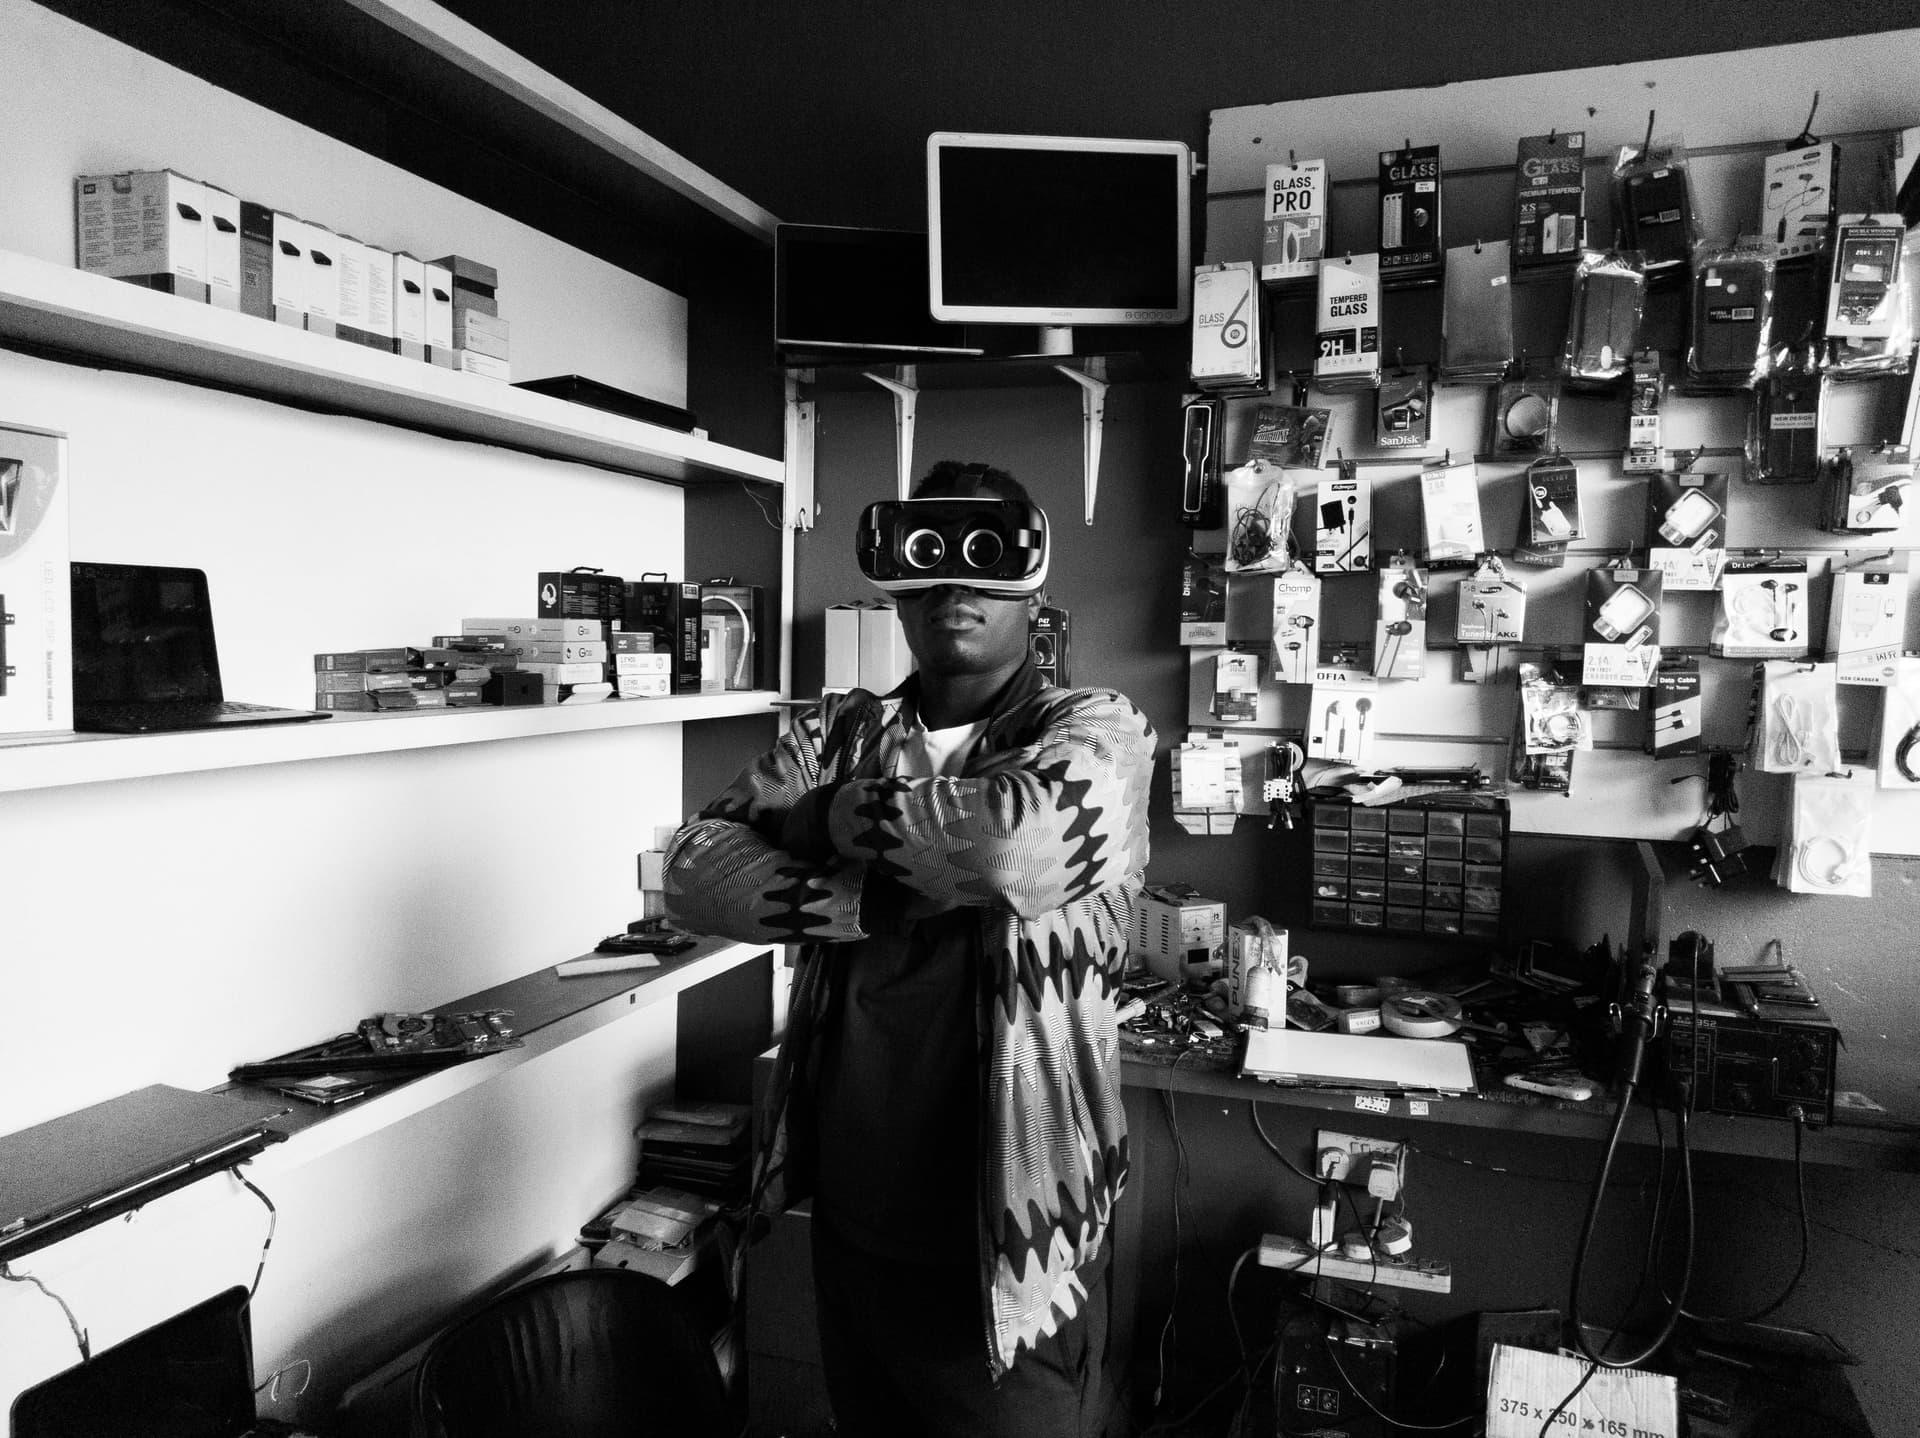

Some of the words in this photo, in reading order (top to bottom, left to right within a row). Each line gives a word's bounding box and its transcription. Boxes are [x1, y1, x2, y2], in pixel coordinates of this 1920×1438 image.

[1389, 163, 1437, 180] GLASS
[1523, 158, 1580, 177] GLASS
[1273, 176, 1312, 191] GLASS
[1521, 203, 1537, 213] XS
[1267, 225, 1280, 234] XS
[1330, 294, 1368, 304] TEMPERED
[1330, 303, 1368, 317] GLASS
[1199, 312, 1225, 325] GLASS
[1320, 340, 1345, 357] 9H
[1380, 435, 1421, 446] SanDisk
[1278, 583, 1313, 595] Champ
[1461, 629, 1485, 638] Tuned
[1317, 672, 1346, 682] OFIA
[1232, 931, 1242, 1007] PUNEX
[1500, 1398, 1529, 1417] 375
[1533, 1407, 1543, 1420] x
[1582, 1417, 1594, 1430] x
[1598, 1420, 1628, 1438] 165
